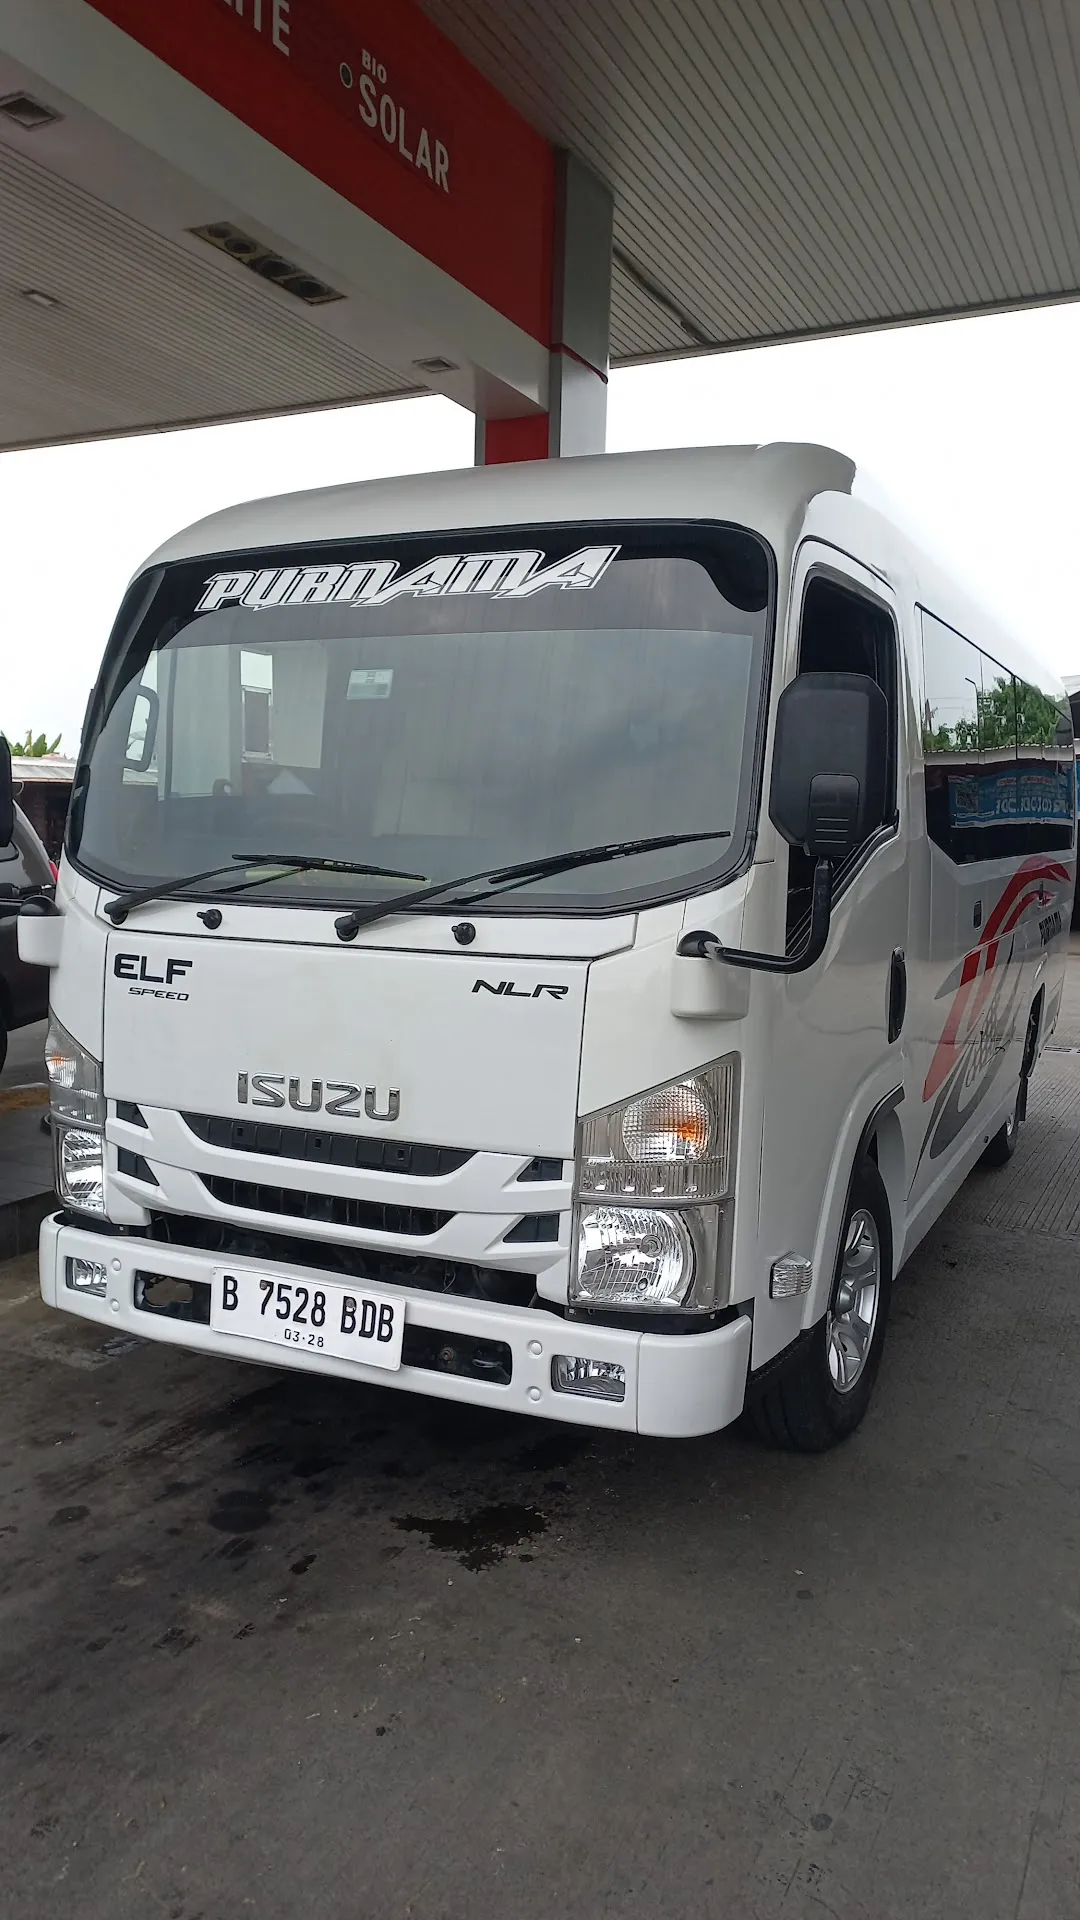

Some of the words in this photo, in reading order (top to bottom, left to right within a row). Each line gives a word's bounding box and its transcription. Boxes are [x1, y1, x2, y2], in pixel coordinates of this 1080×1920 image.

[361, 48, 387, 84] BIO
[358, 73, 450, 194] SOLAR
[194, 544, 623, 613] PURNAMA
[114, 952, 193, 984] ELF
[471, 979, 569, 1000] NLR
[127, 986, 189, 1002] SPEED
[237, 1069, 400, 1121] ISUZU
[222, 1275, 239, 1311] B
[259, 1280, 326, 1327] 7528
[340, 1296, 394, 1342] BDB
